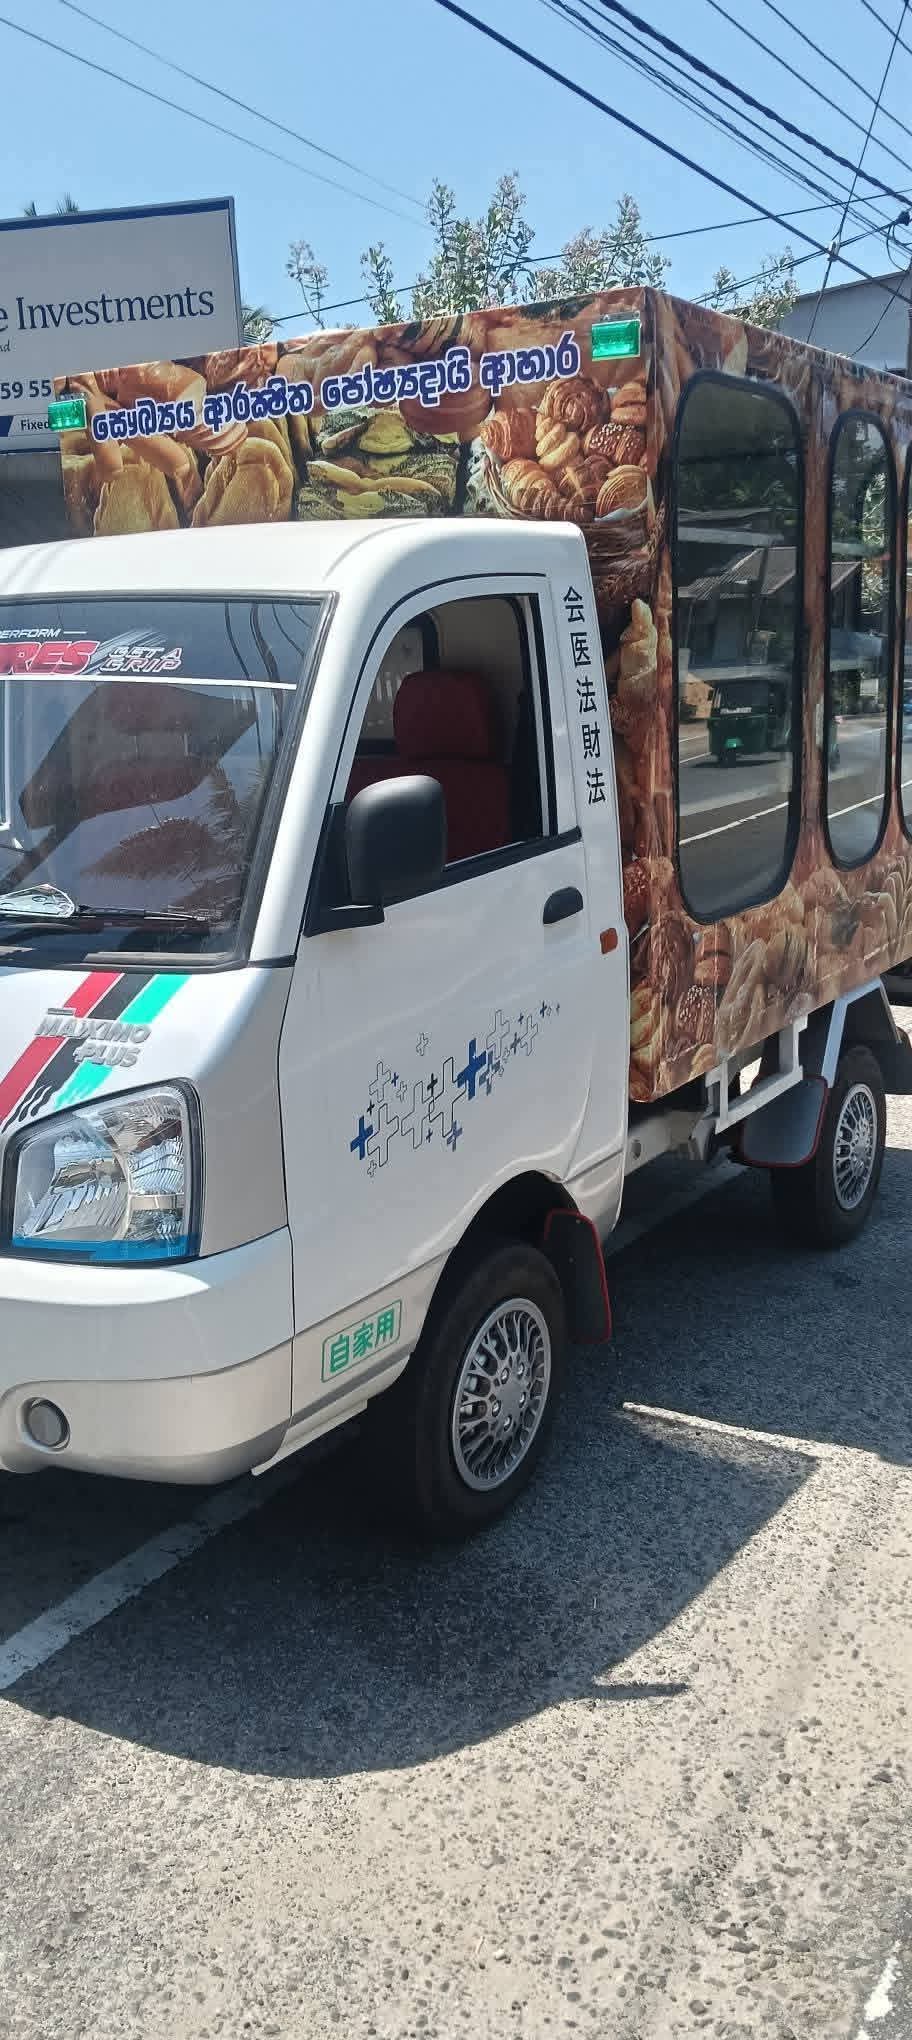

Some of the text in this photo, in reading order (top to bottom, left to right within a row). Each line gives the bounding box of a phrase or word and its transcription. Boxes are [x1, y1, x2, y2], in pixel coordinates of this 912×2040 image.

[16, 287, 214, 330] Investments
[481, 333, 579, 395] ආහාර
[0, 379, 51, 399] 59 55
[99, 657, 182, 672] GRIP
[109, 646, 182, 660] GET A
[330, 1308, 394, 1373] 自家用
